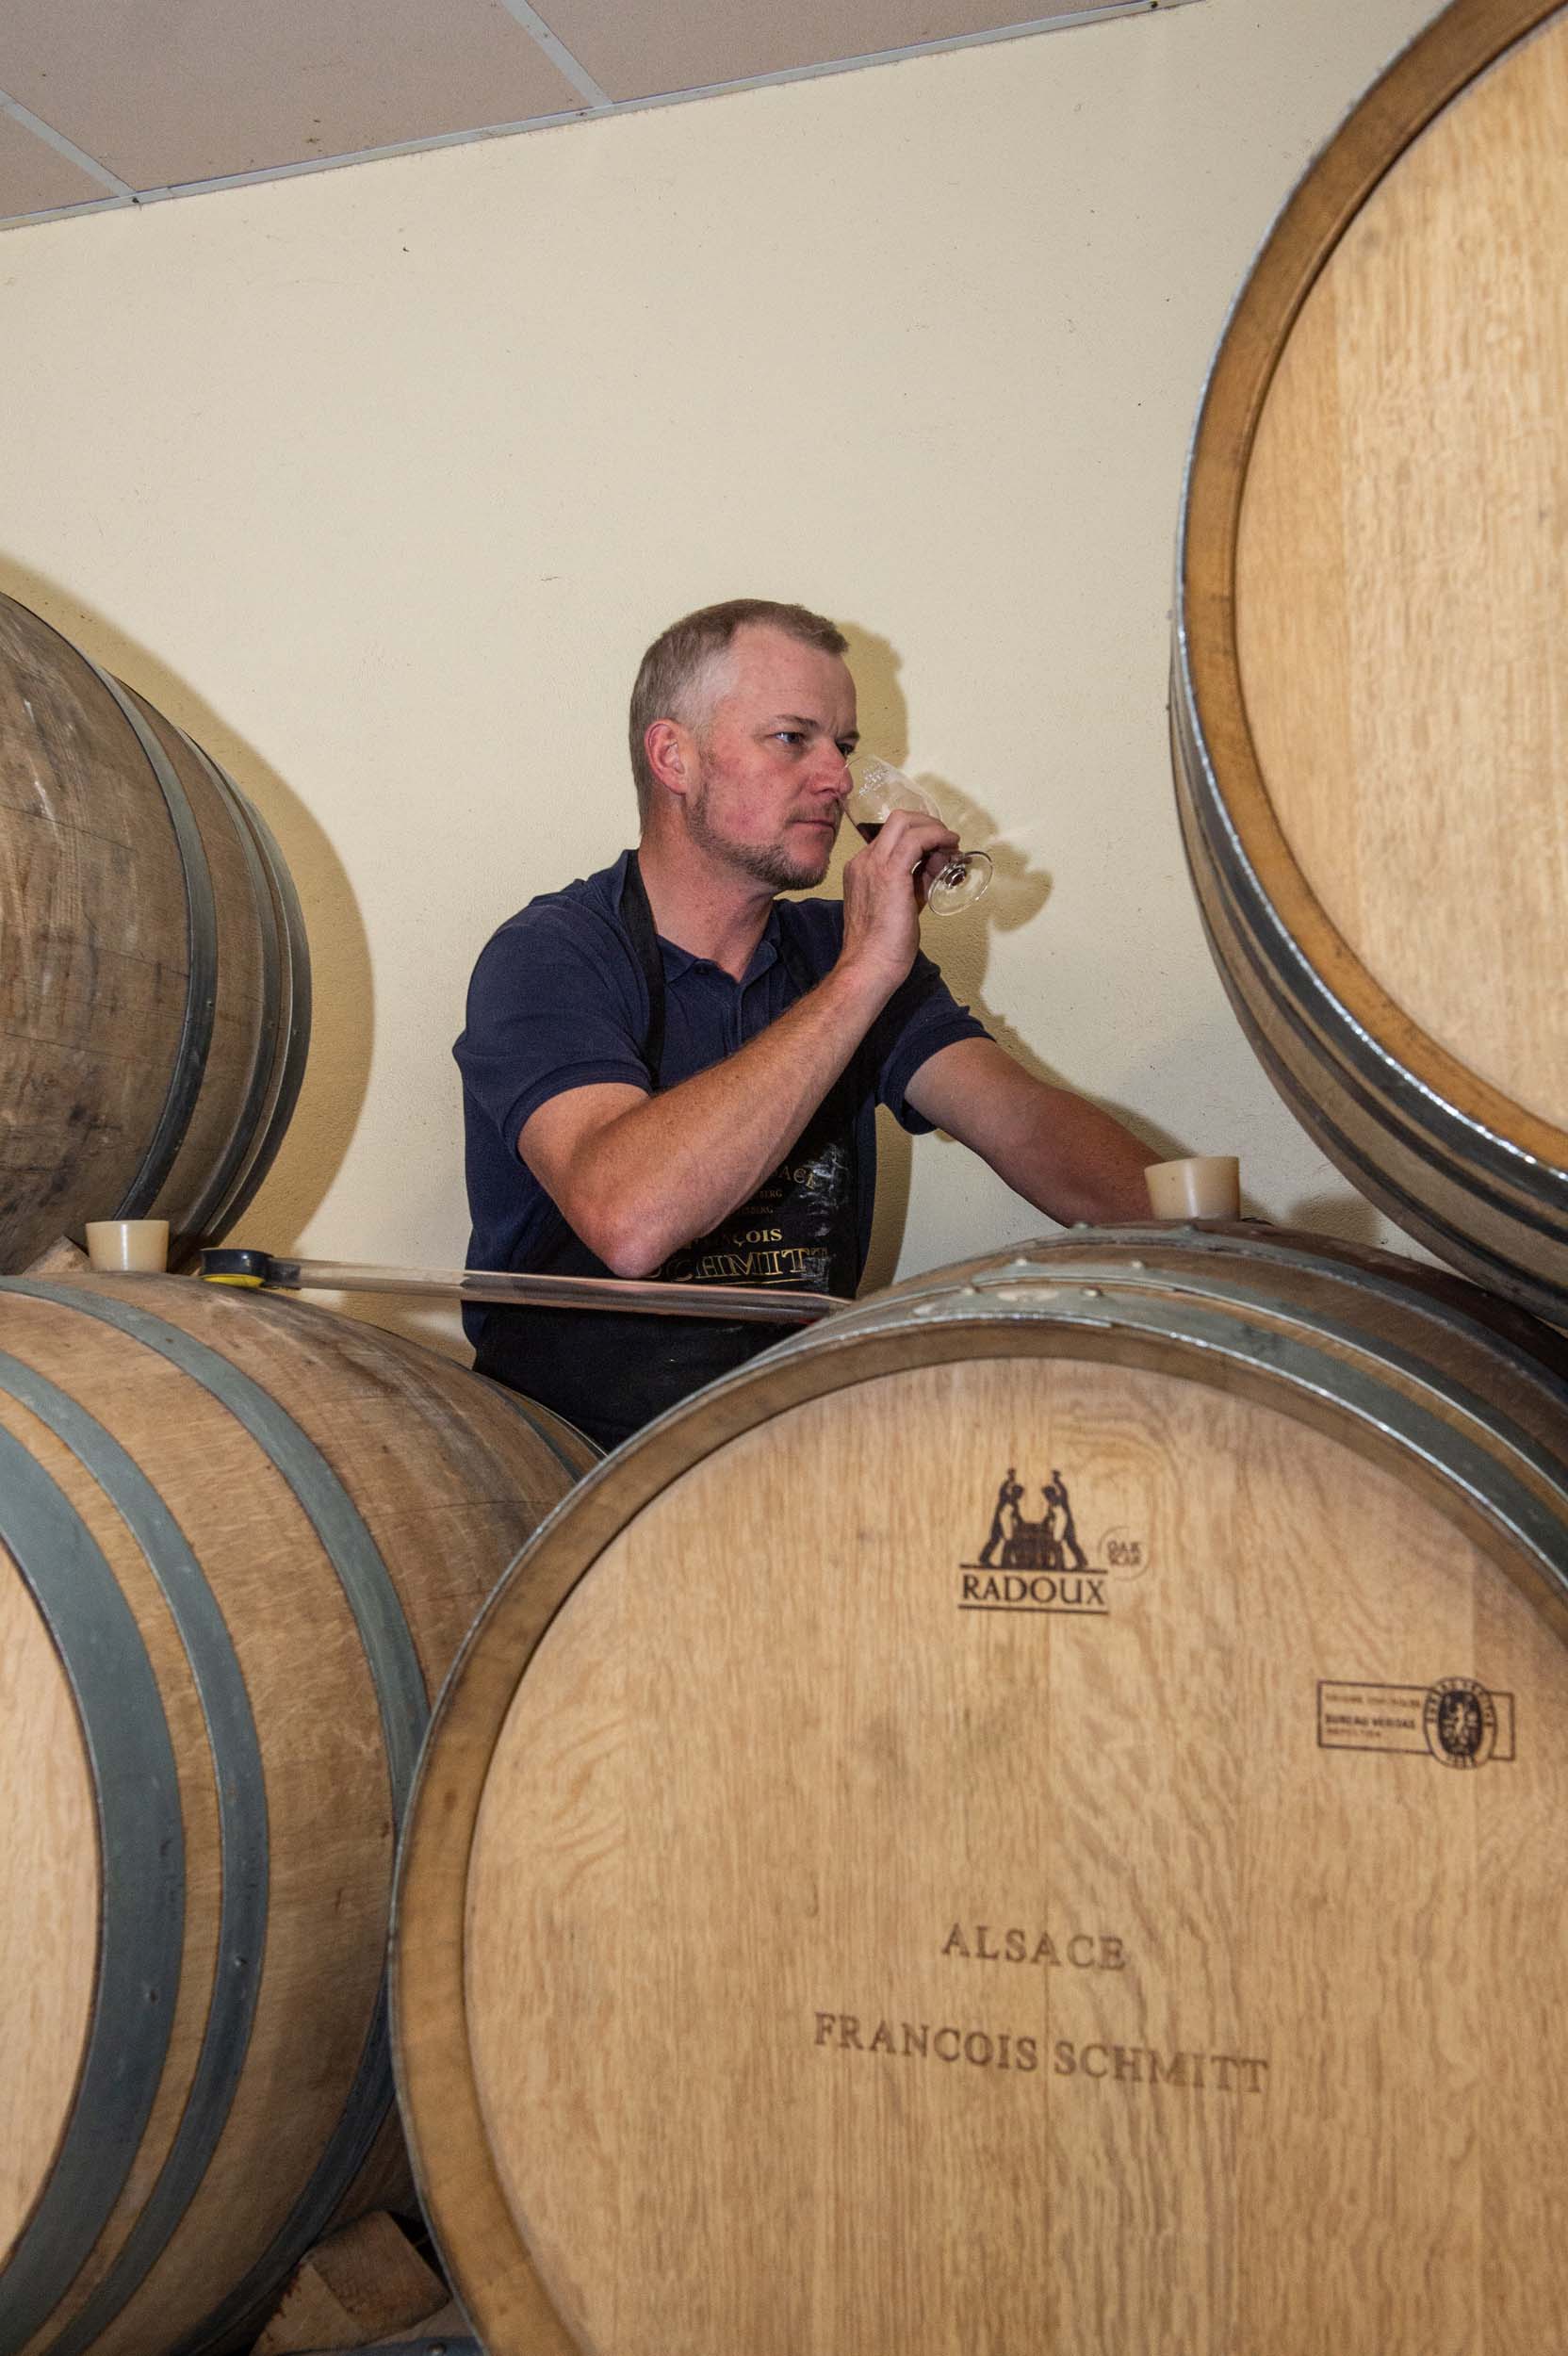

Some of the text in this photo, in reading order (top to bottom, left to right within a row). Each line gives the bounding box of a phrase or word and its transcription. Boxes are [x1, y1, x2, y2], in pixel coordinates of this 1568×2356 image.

[961, 1573, 1105, 1606] RADOUX
[941, 1922, 1126, 1972] ALSACE
[813, 2011, 1269, 2094] FRANCOIS SCHMITT
